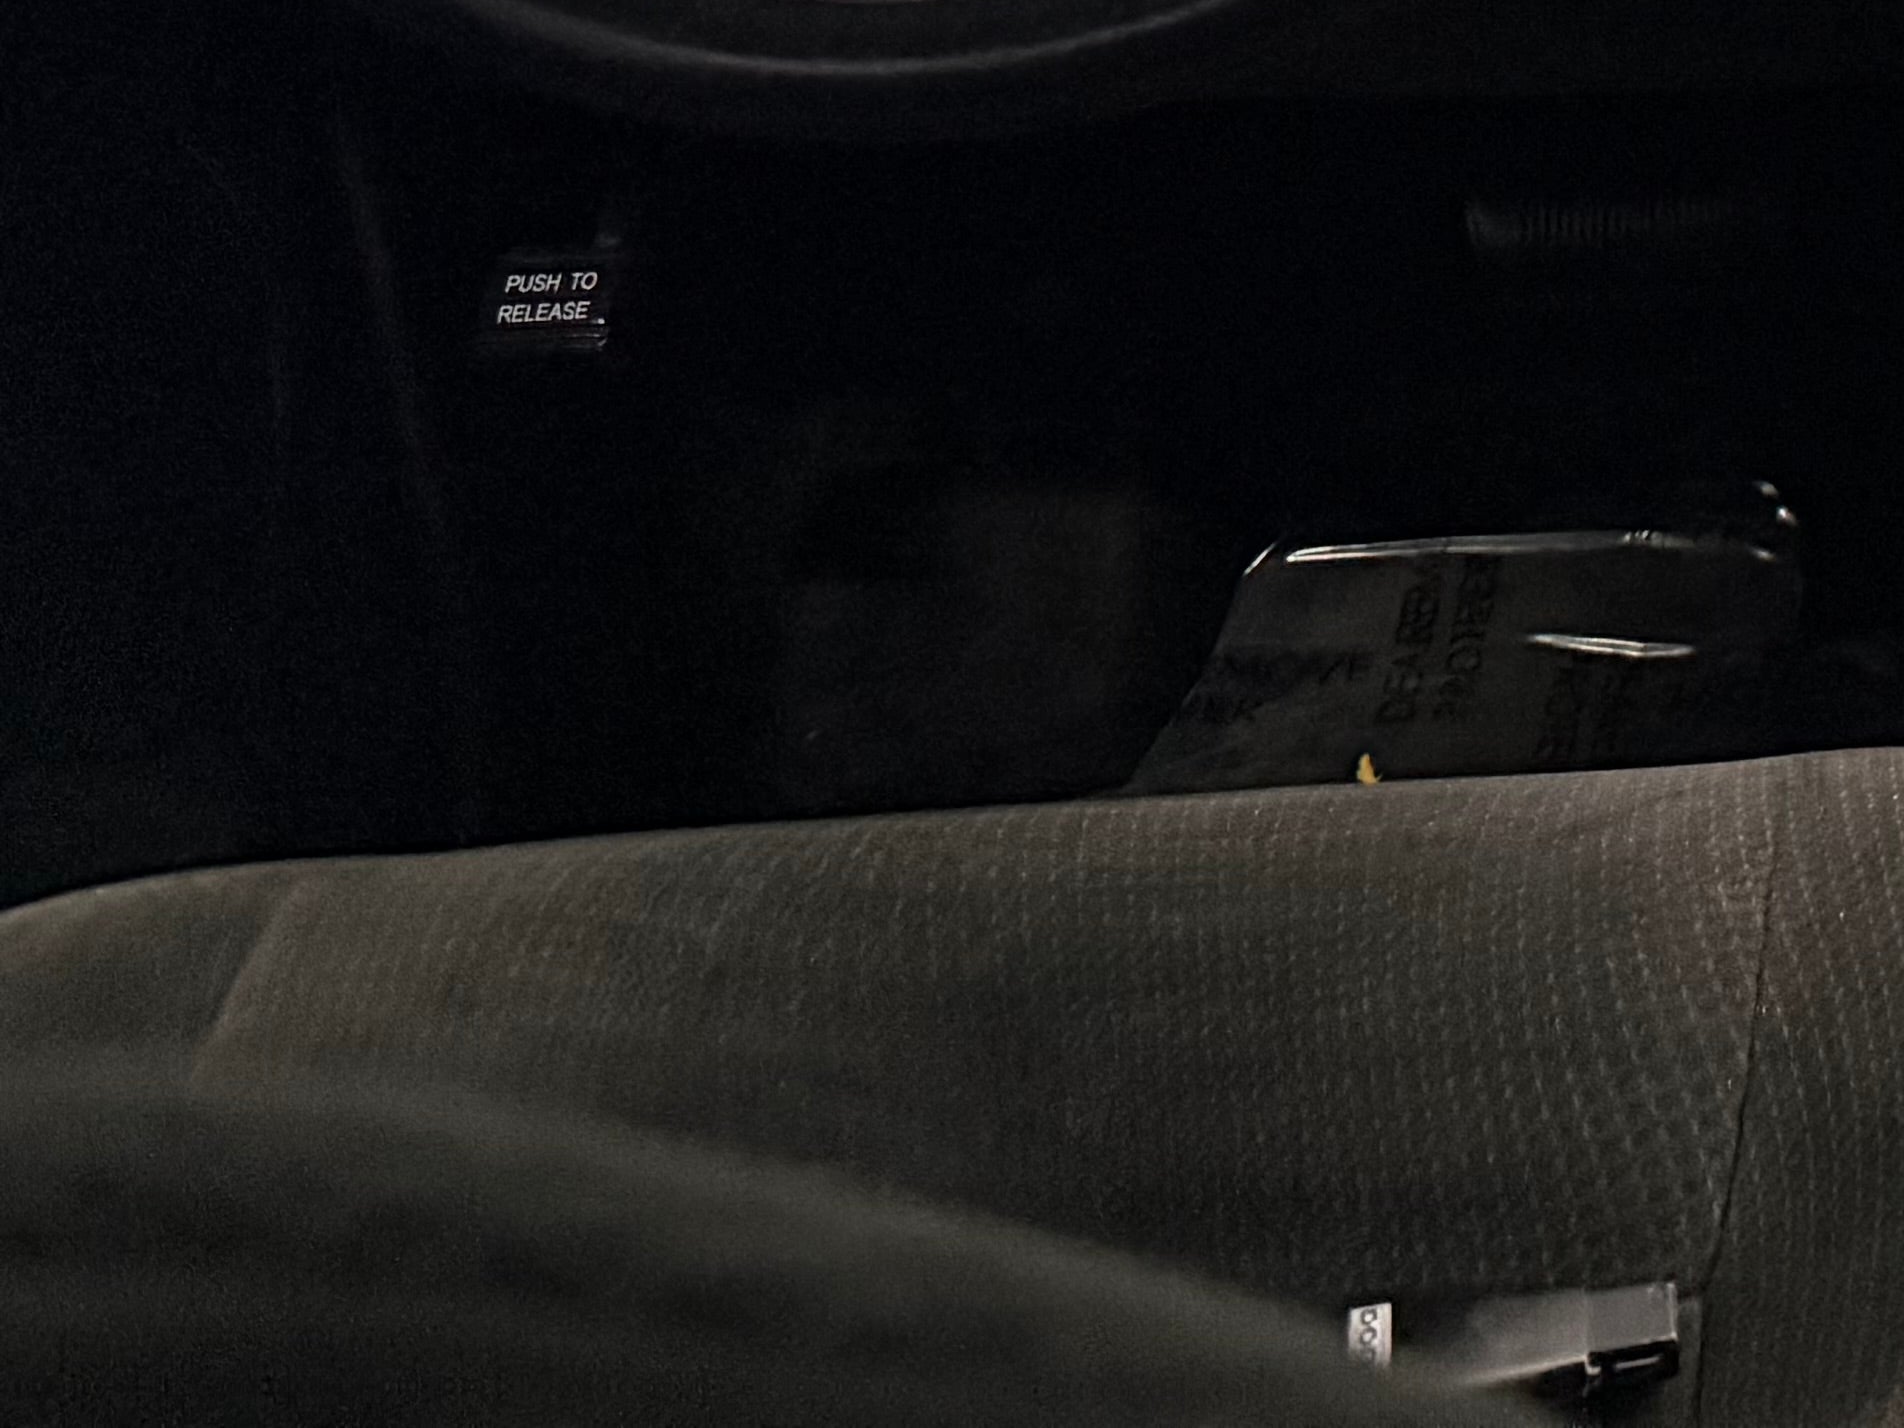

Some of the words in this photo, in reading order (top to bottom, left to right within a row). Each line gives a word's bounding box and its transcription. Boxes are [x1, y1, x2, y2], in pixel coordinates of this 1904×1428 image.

[504, 272, 562, 294] PUSH
[570, 271, 598, 291] TO
[496, 300, 591, 324] RELEASE
